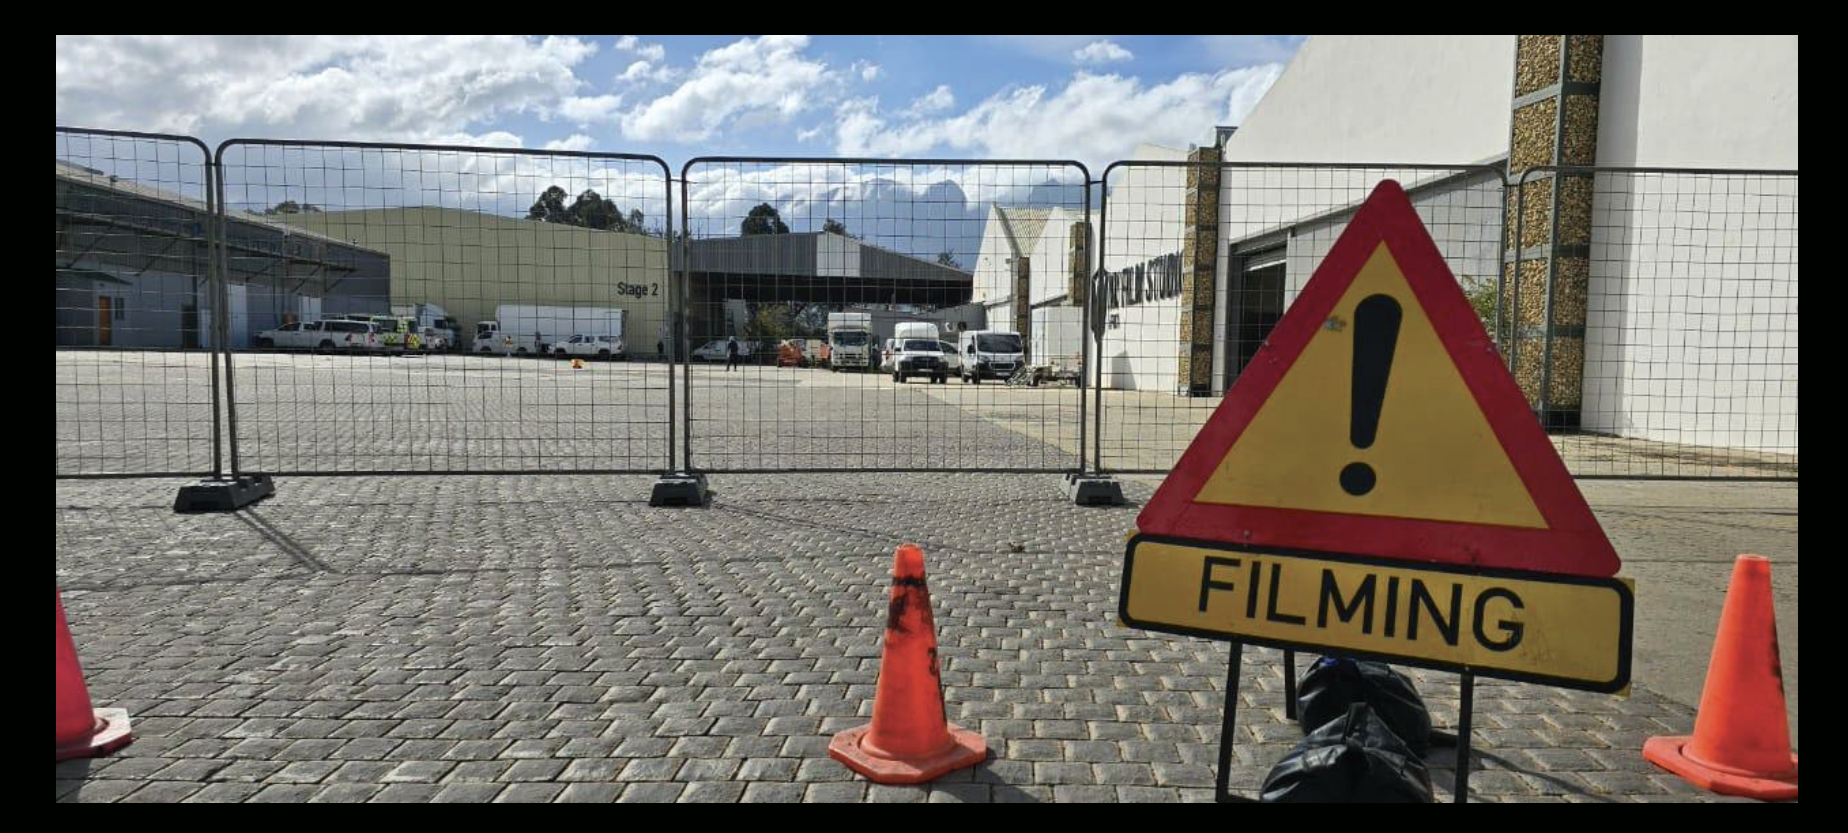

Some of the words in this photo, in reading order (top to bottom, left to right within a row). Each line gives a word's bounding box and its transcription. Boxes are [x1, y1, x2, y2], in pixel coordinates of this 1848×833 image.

[617, 281, 649, 299] Stage
[651, 282, 659, 296] 2
[1198, 555, 1526, 653] FILMING
